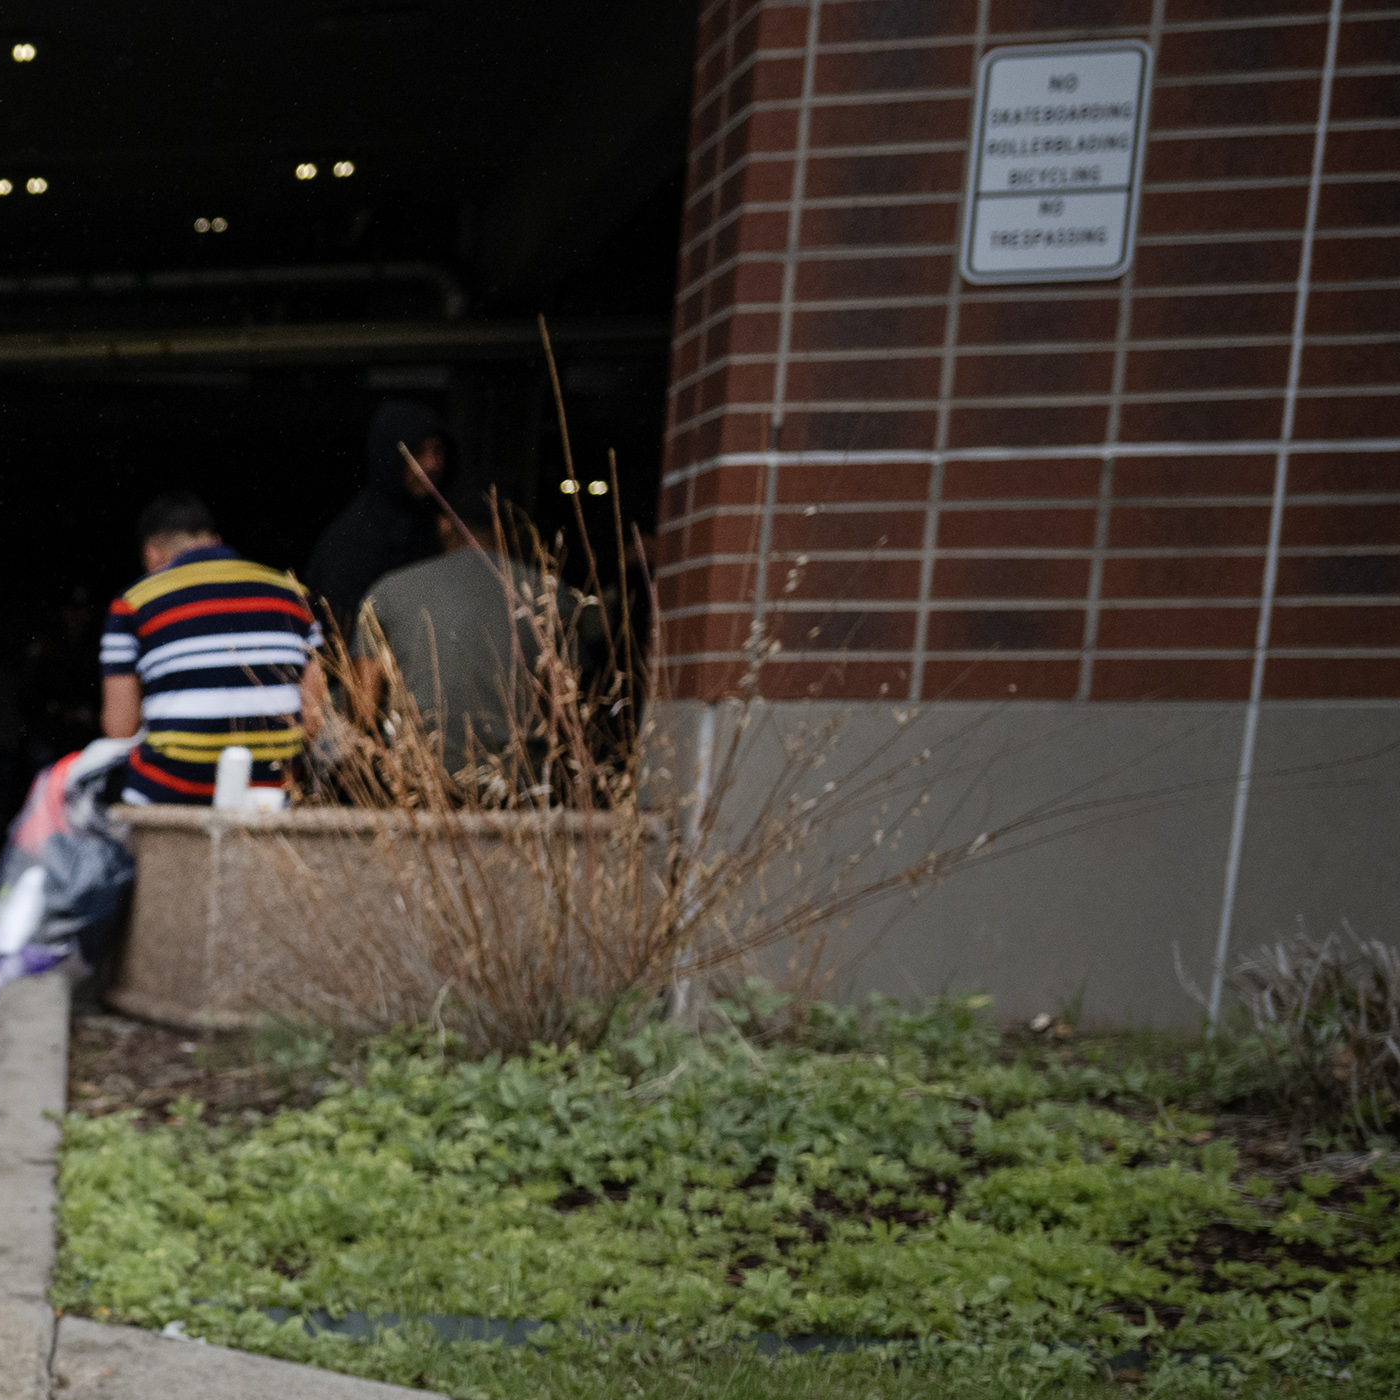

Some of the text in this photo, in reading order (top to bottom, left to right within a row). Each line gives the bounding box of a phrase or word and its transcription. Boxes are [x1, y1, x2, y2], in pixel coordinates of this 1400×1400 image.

[1048, 73, 1079, 93] NO
[990, 103, 1133, 127] SKATEBOARDING
[987, 132, 1130, 157] ROLLERBLADING
[1007, 164, 1101, 186] BICYCLING
[1038, 199, 1064, 217] NO
[991, 226, 1107, 248] TRESPASSING
